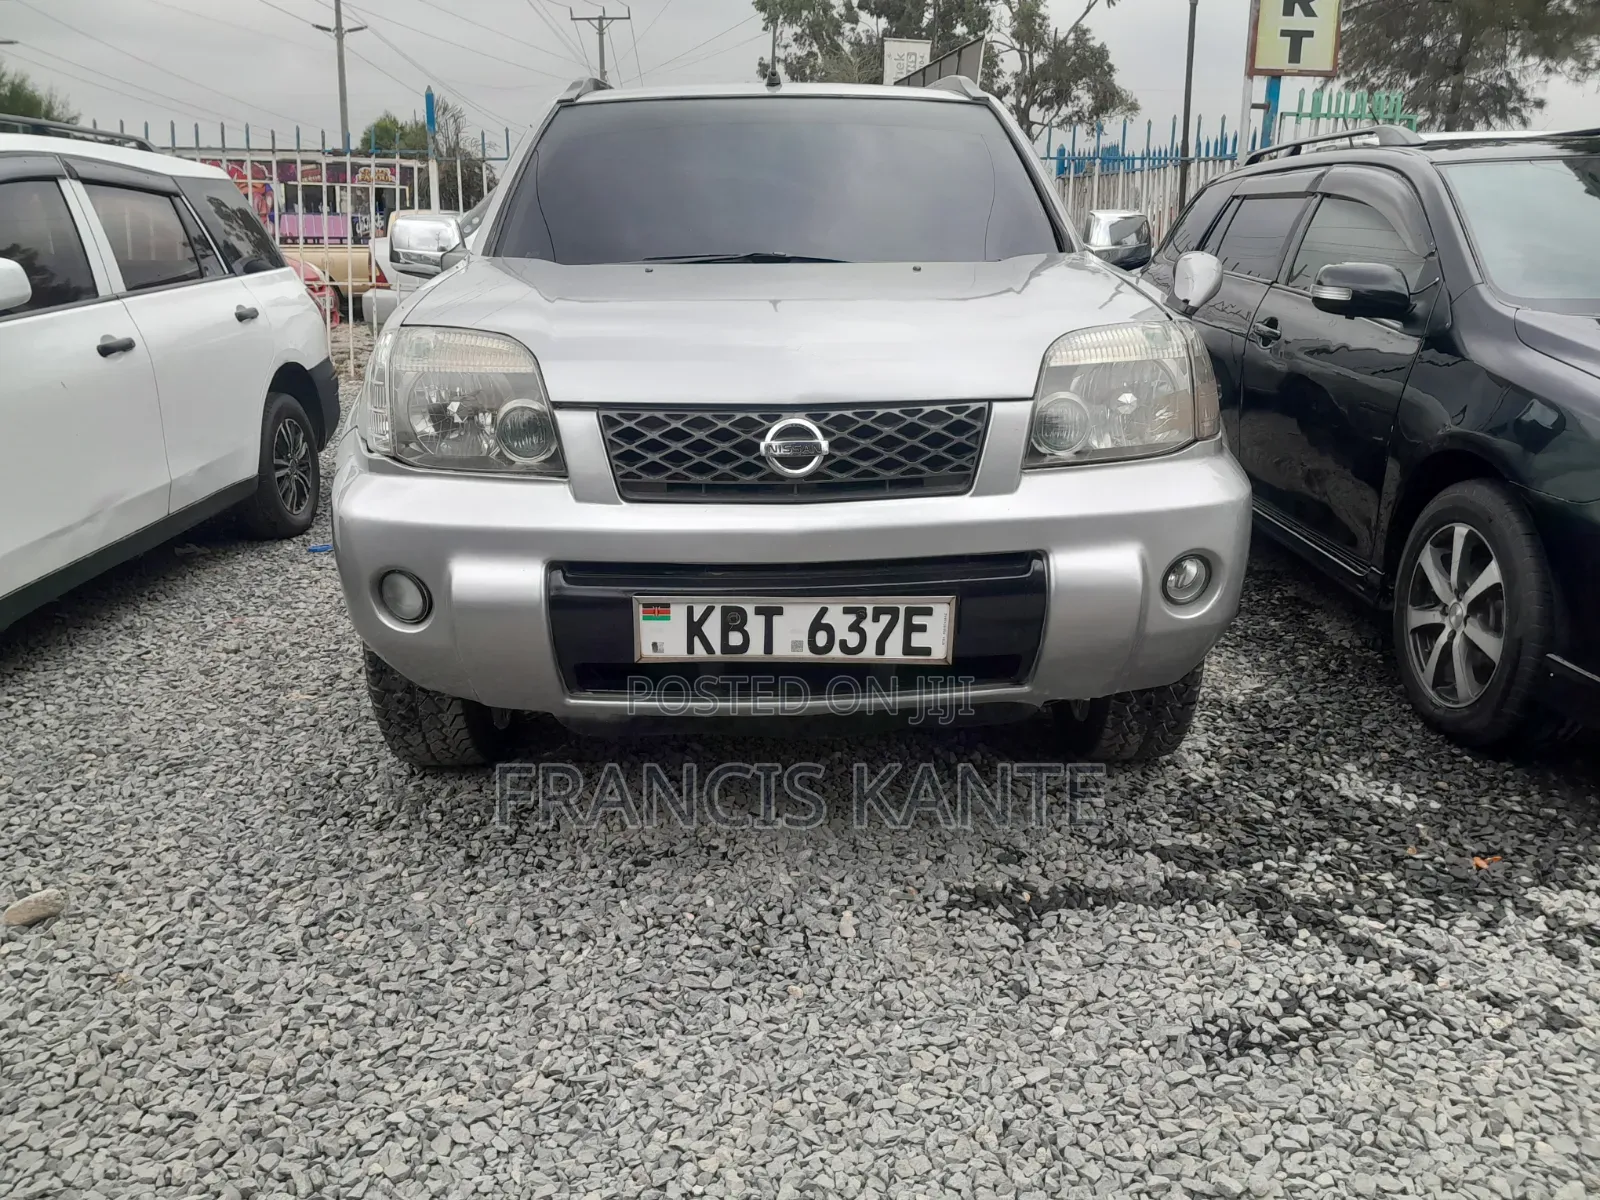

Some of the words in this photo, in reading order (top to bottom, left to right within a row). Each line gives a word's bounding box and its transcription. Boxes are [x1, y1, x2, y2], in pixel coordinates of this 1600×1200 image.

[767, 444, 823, 455] NISSAN
[685, 605, 784, 656] KBT
[807, 605, 934, 657] 637E
